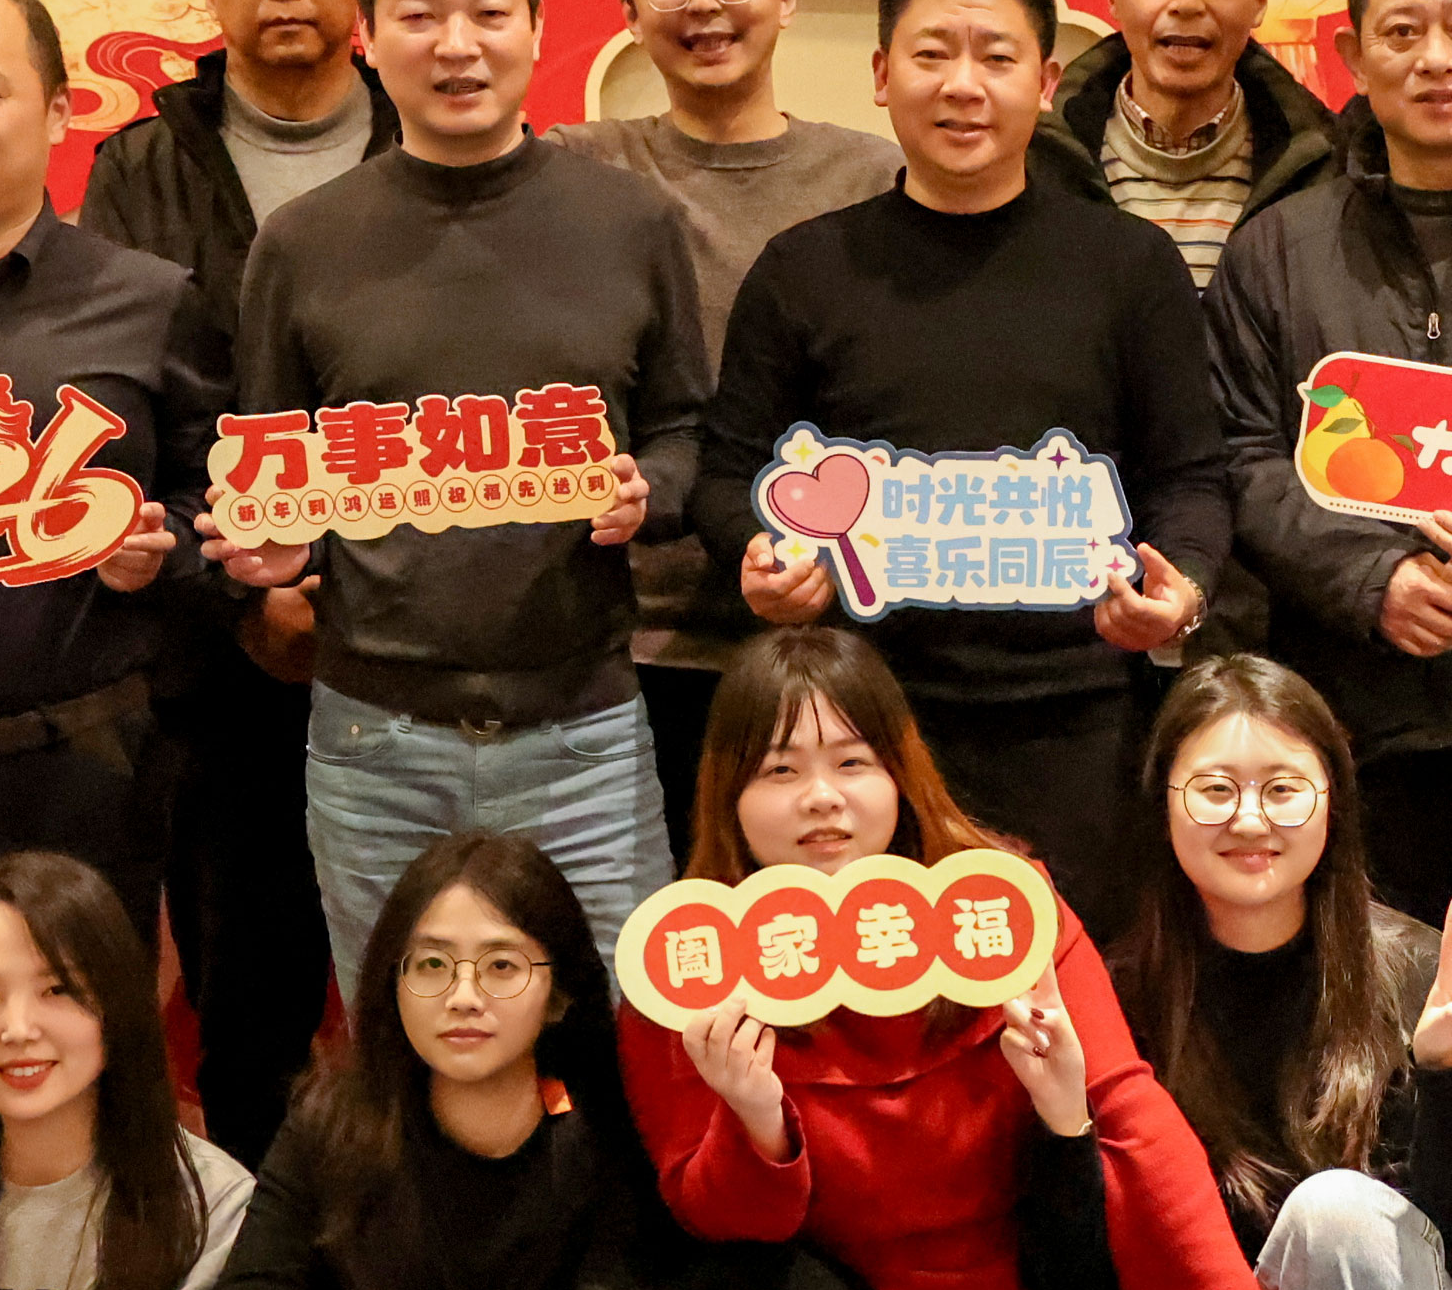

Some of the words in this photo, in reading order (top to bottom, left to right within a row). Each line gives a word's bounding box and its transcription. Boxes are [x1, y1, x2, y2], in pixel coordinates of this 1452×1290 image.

[219, 385, 611, 495] 万事如意
[237, 476, 606, 522] 新年到鸿运照祝福先送到
[882, 473, 1093, 528] 时光共悦
[883, 534, 1092, 589] 喜乐同辰
[664, 895, 1014, 989] 阖家幸福
